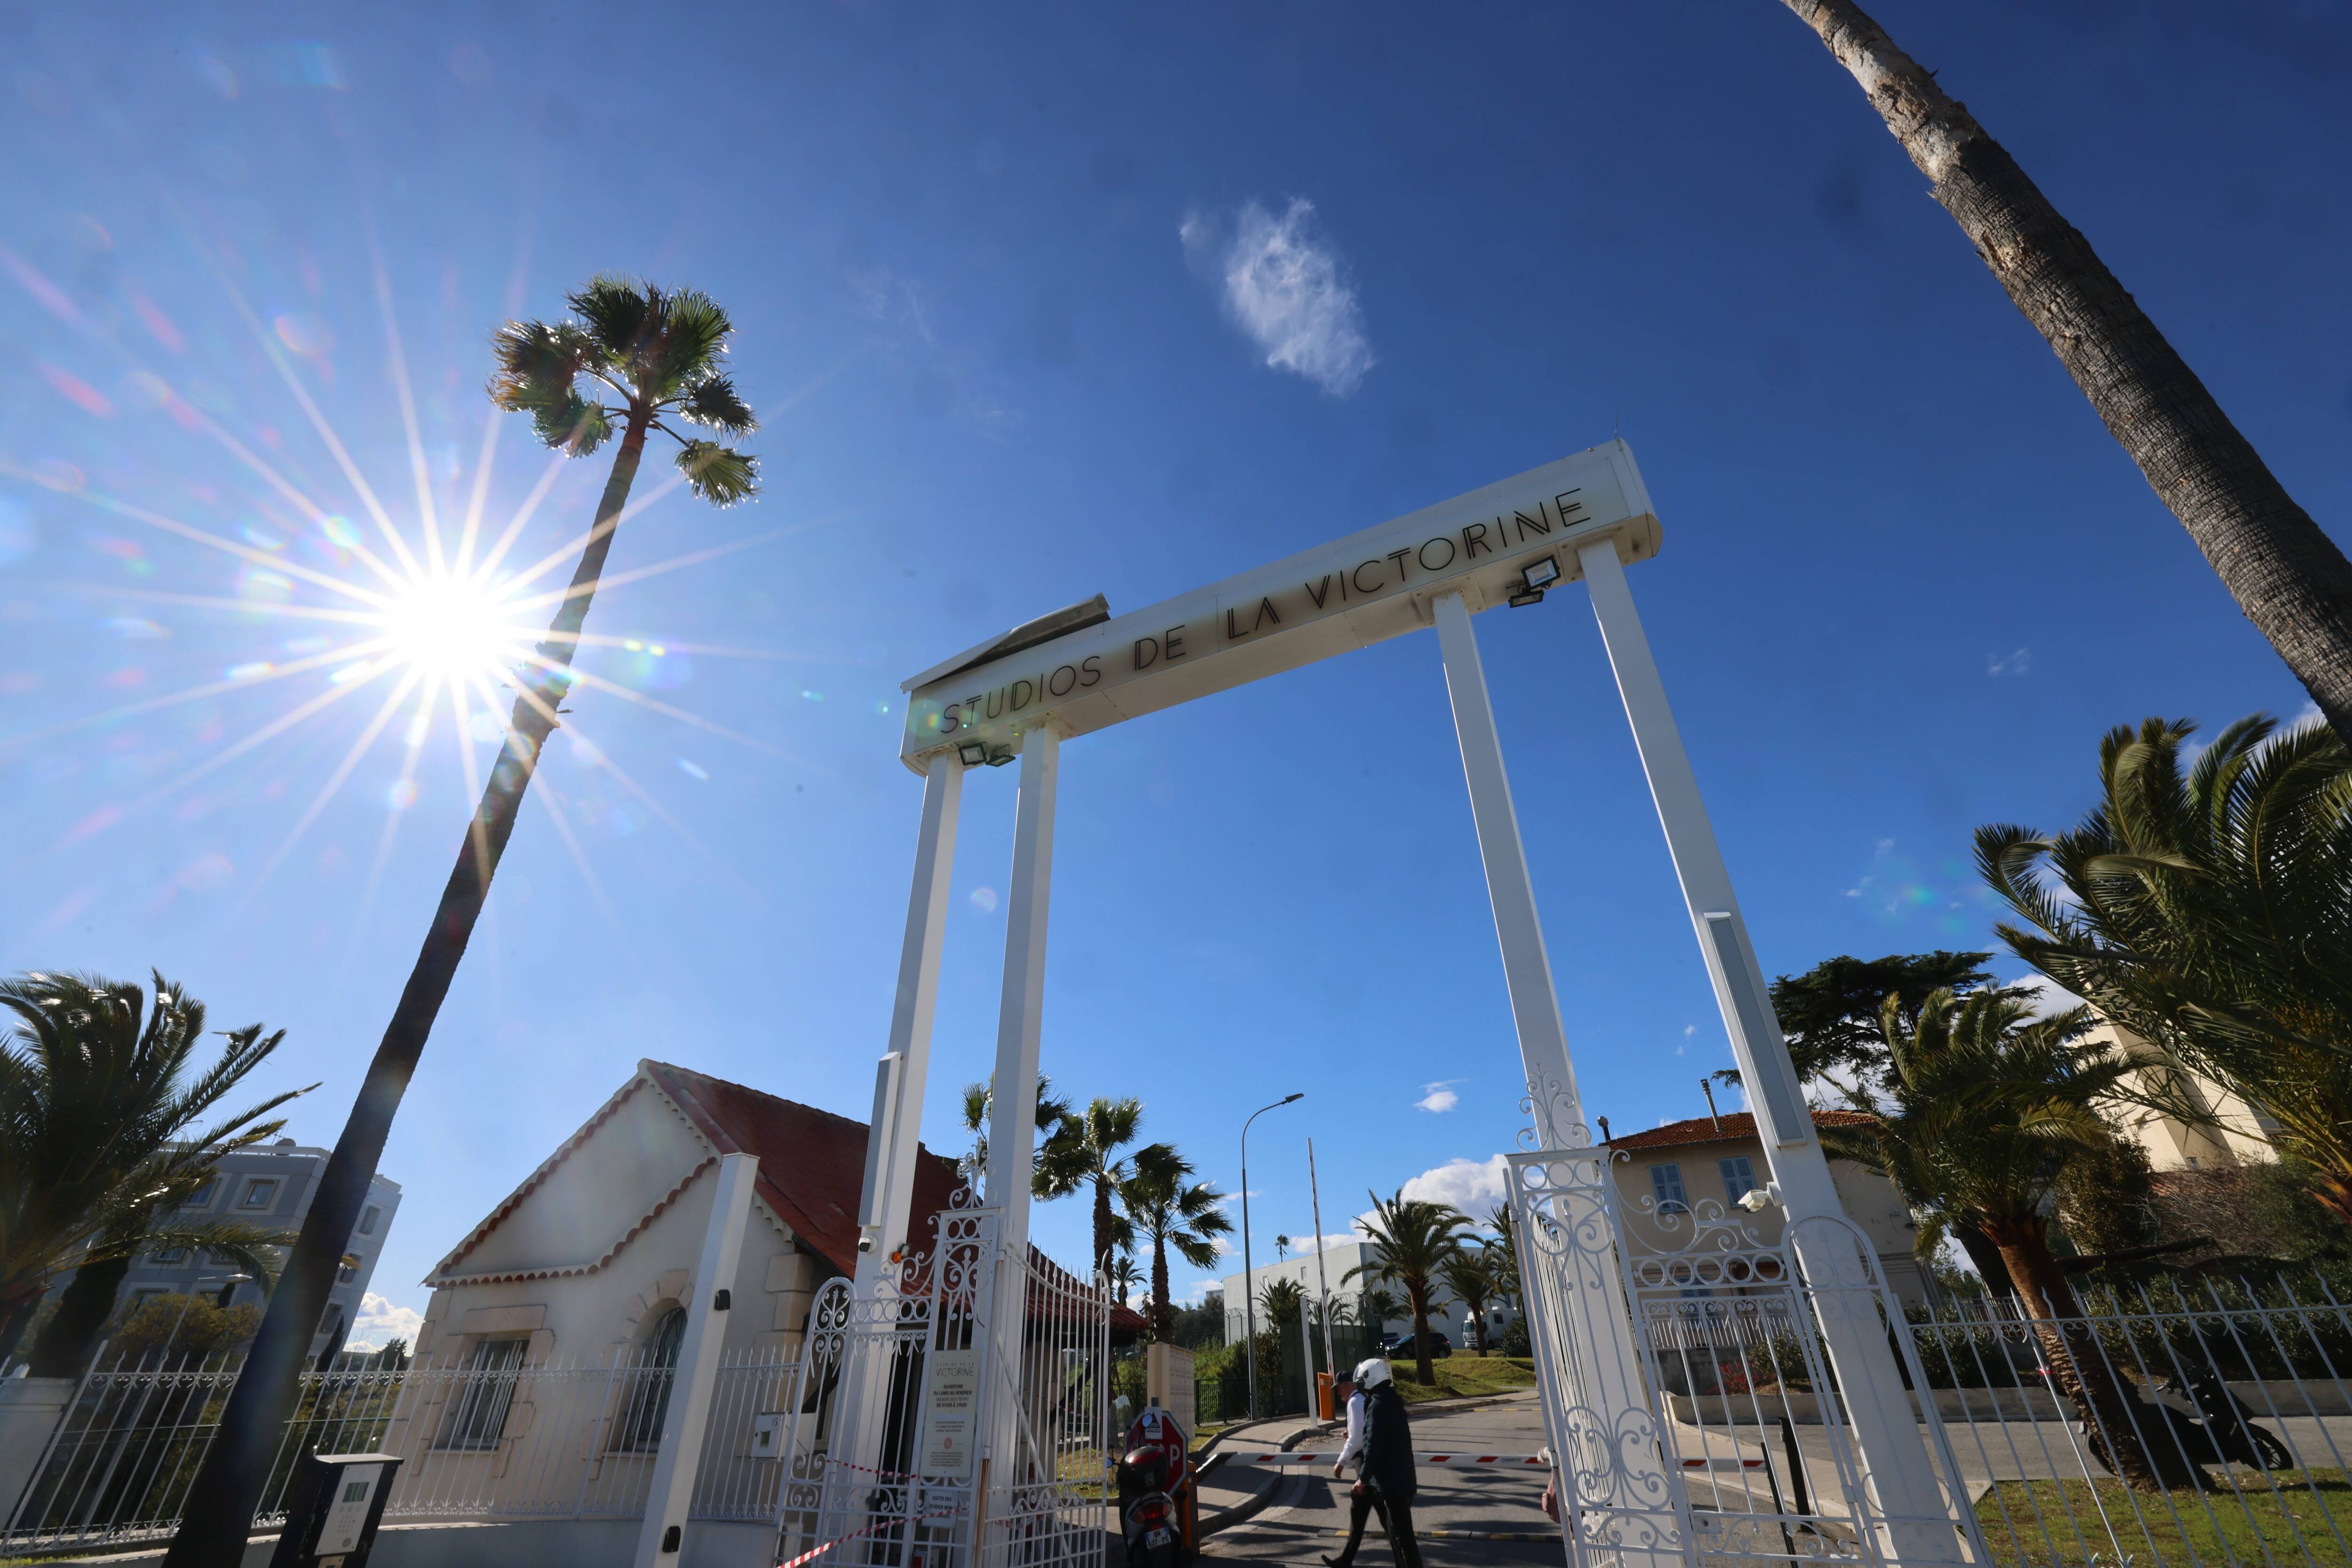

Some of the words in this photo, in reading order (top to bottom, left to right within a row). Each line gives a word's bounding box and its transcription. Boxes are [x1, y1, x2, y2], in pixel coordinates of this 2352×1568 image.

[941, 656, 1101, 733] STUDIOS
[1135, 624, 1186, 671] DE
[1227, 597, 1280, 640] LA
[1304, 488, 1591, 610] VICTORINE
[936, 1367, 973, 1377] VICTORINE
